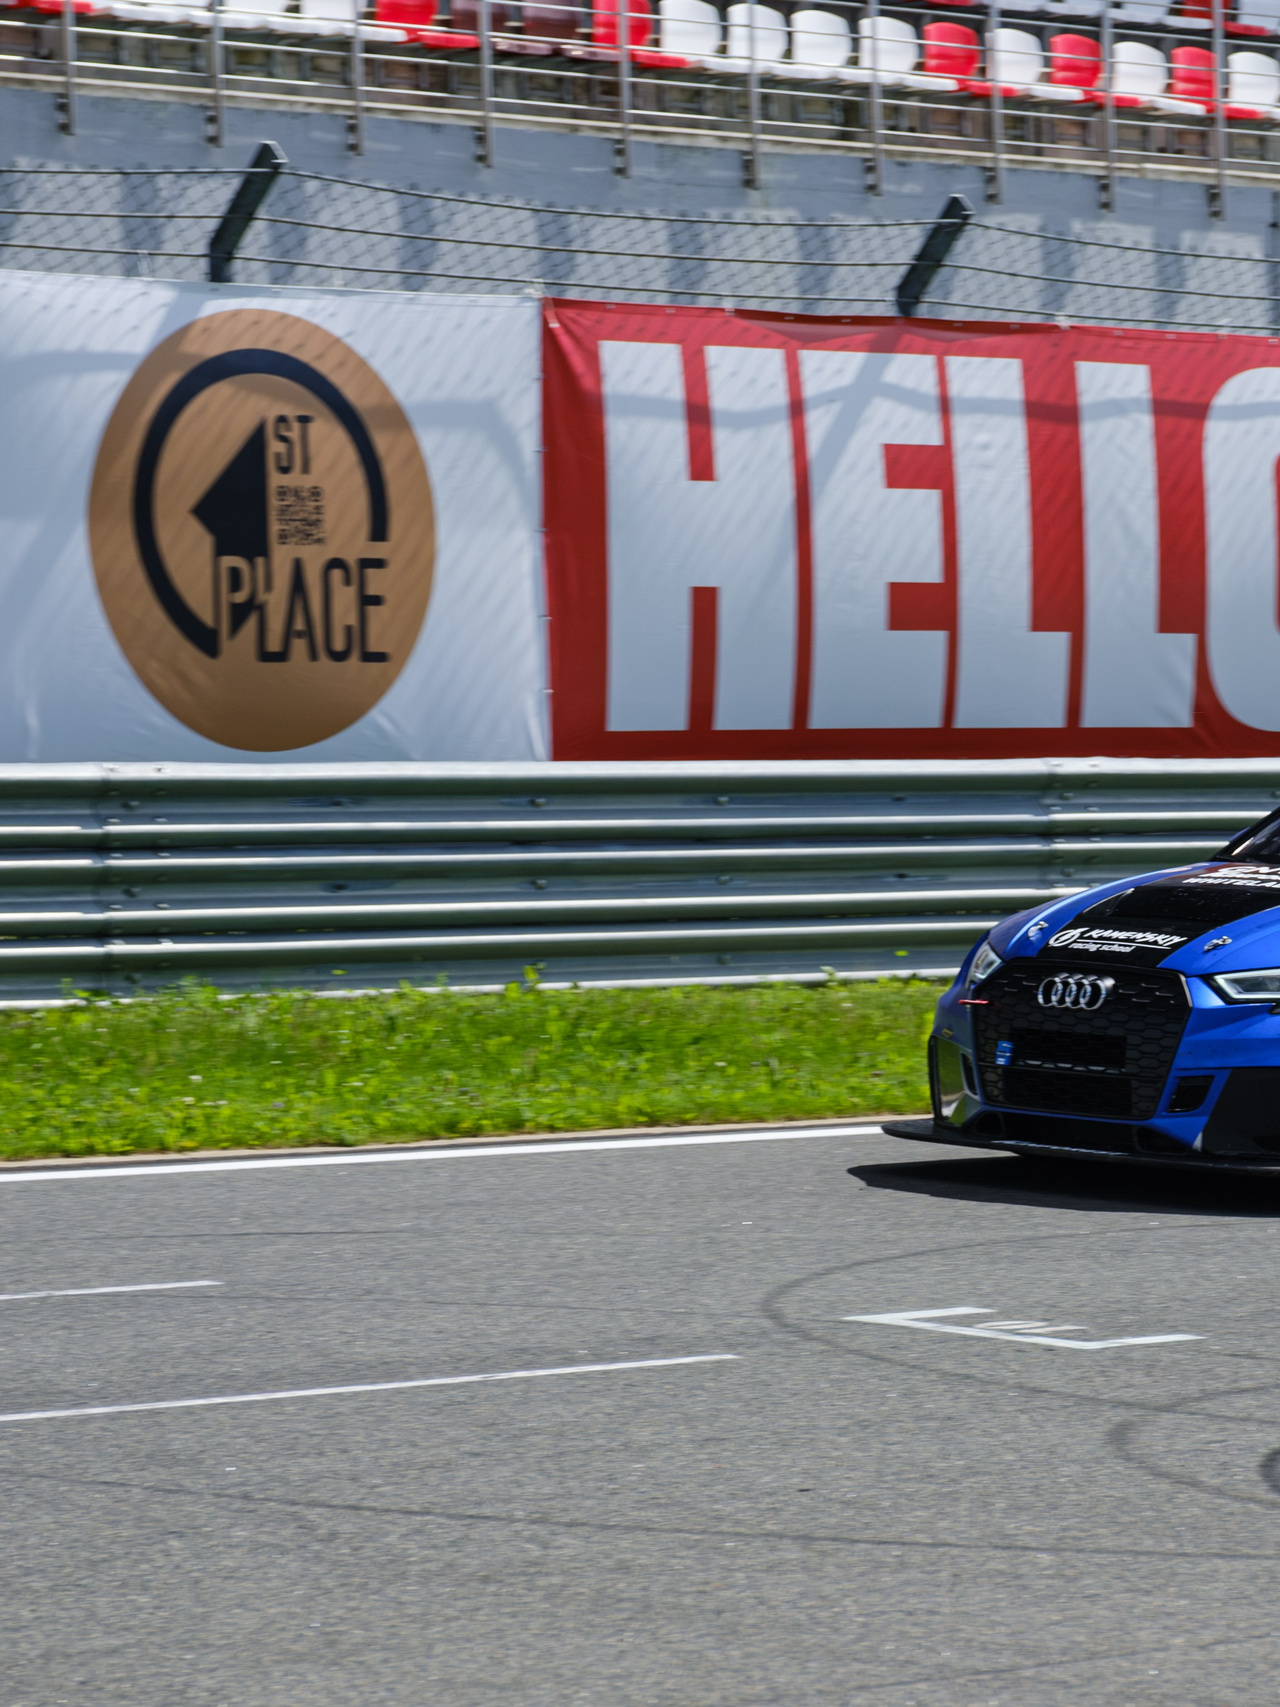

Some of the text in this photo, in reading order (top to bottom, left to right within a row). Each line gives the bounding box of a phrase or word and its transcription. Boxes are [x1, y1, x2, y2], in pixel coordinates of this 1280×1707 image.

[217, 555, 391, 663] PLACE
[1083, 928, 1188, 946] KAMENSKIY
[1068, 942, 1136, 952] racing school
